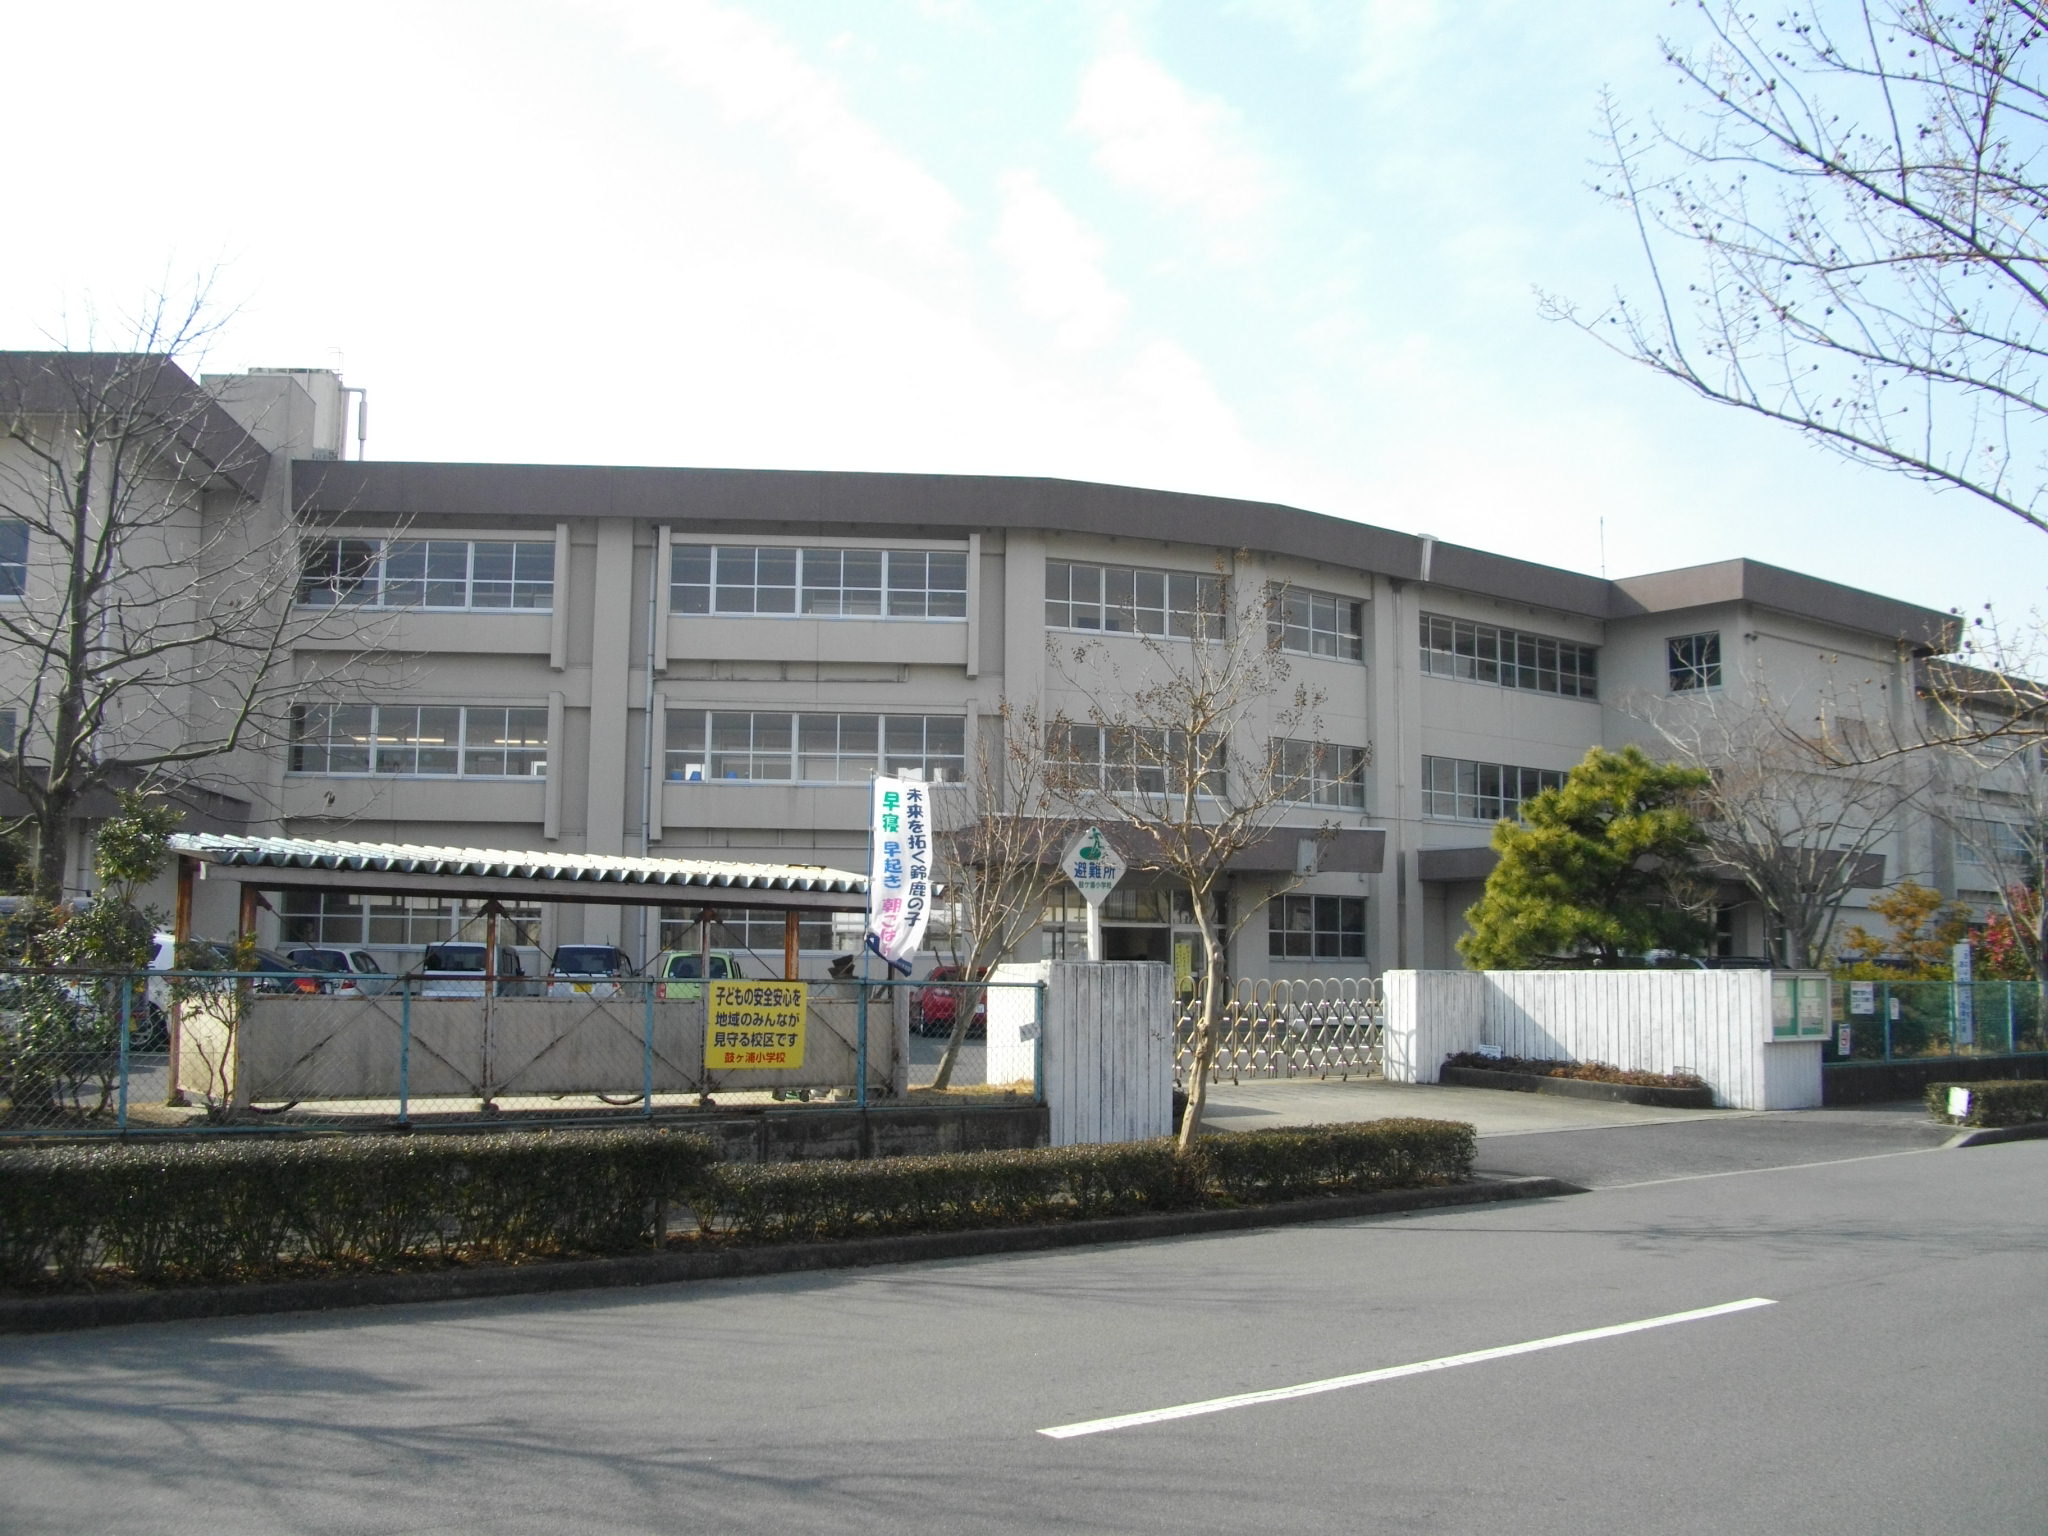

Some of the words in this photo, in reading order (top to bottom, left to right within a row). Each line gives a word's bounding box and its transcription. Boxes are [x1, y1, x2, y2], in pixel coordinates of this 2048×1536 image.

[882, 791, 900, 833] 早寝
[883, 841, 903, 889] 早起き
[904, 788, 927, 927] 未来を拓く鈴鹿の子
[1074, 861, 1116, 880] 避難所
[715, 986, 801, 1007] 子どもの安全安心を
[715, 1011, 800, 1027] 地域のみんなが
[714, 1032, 798, 1048] 見守る校区です
